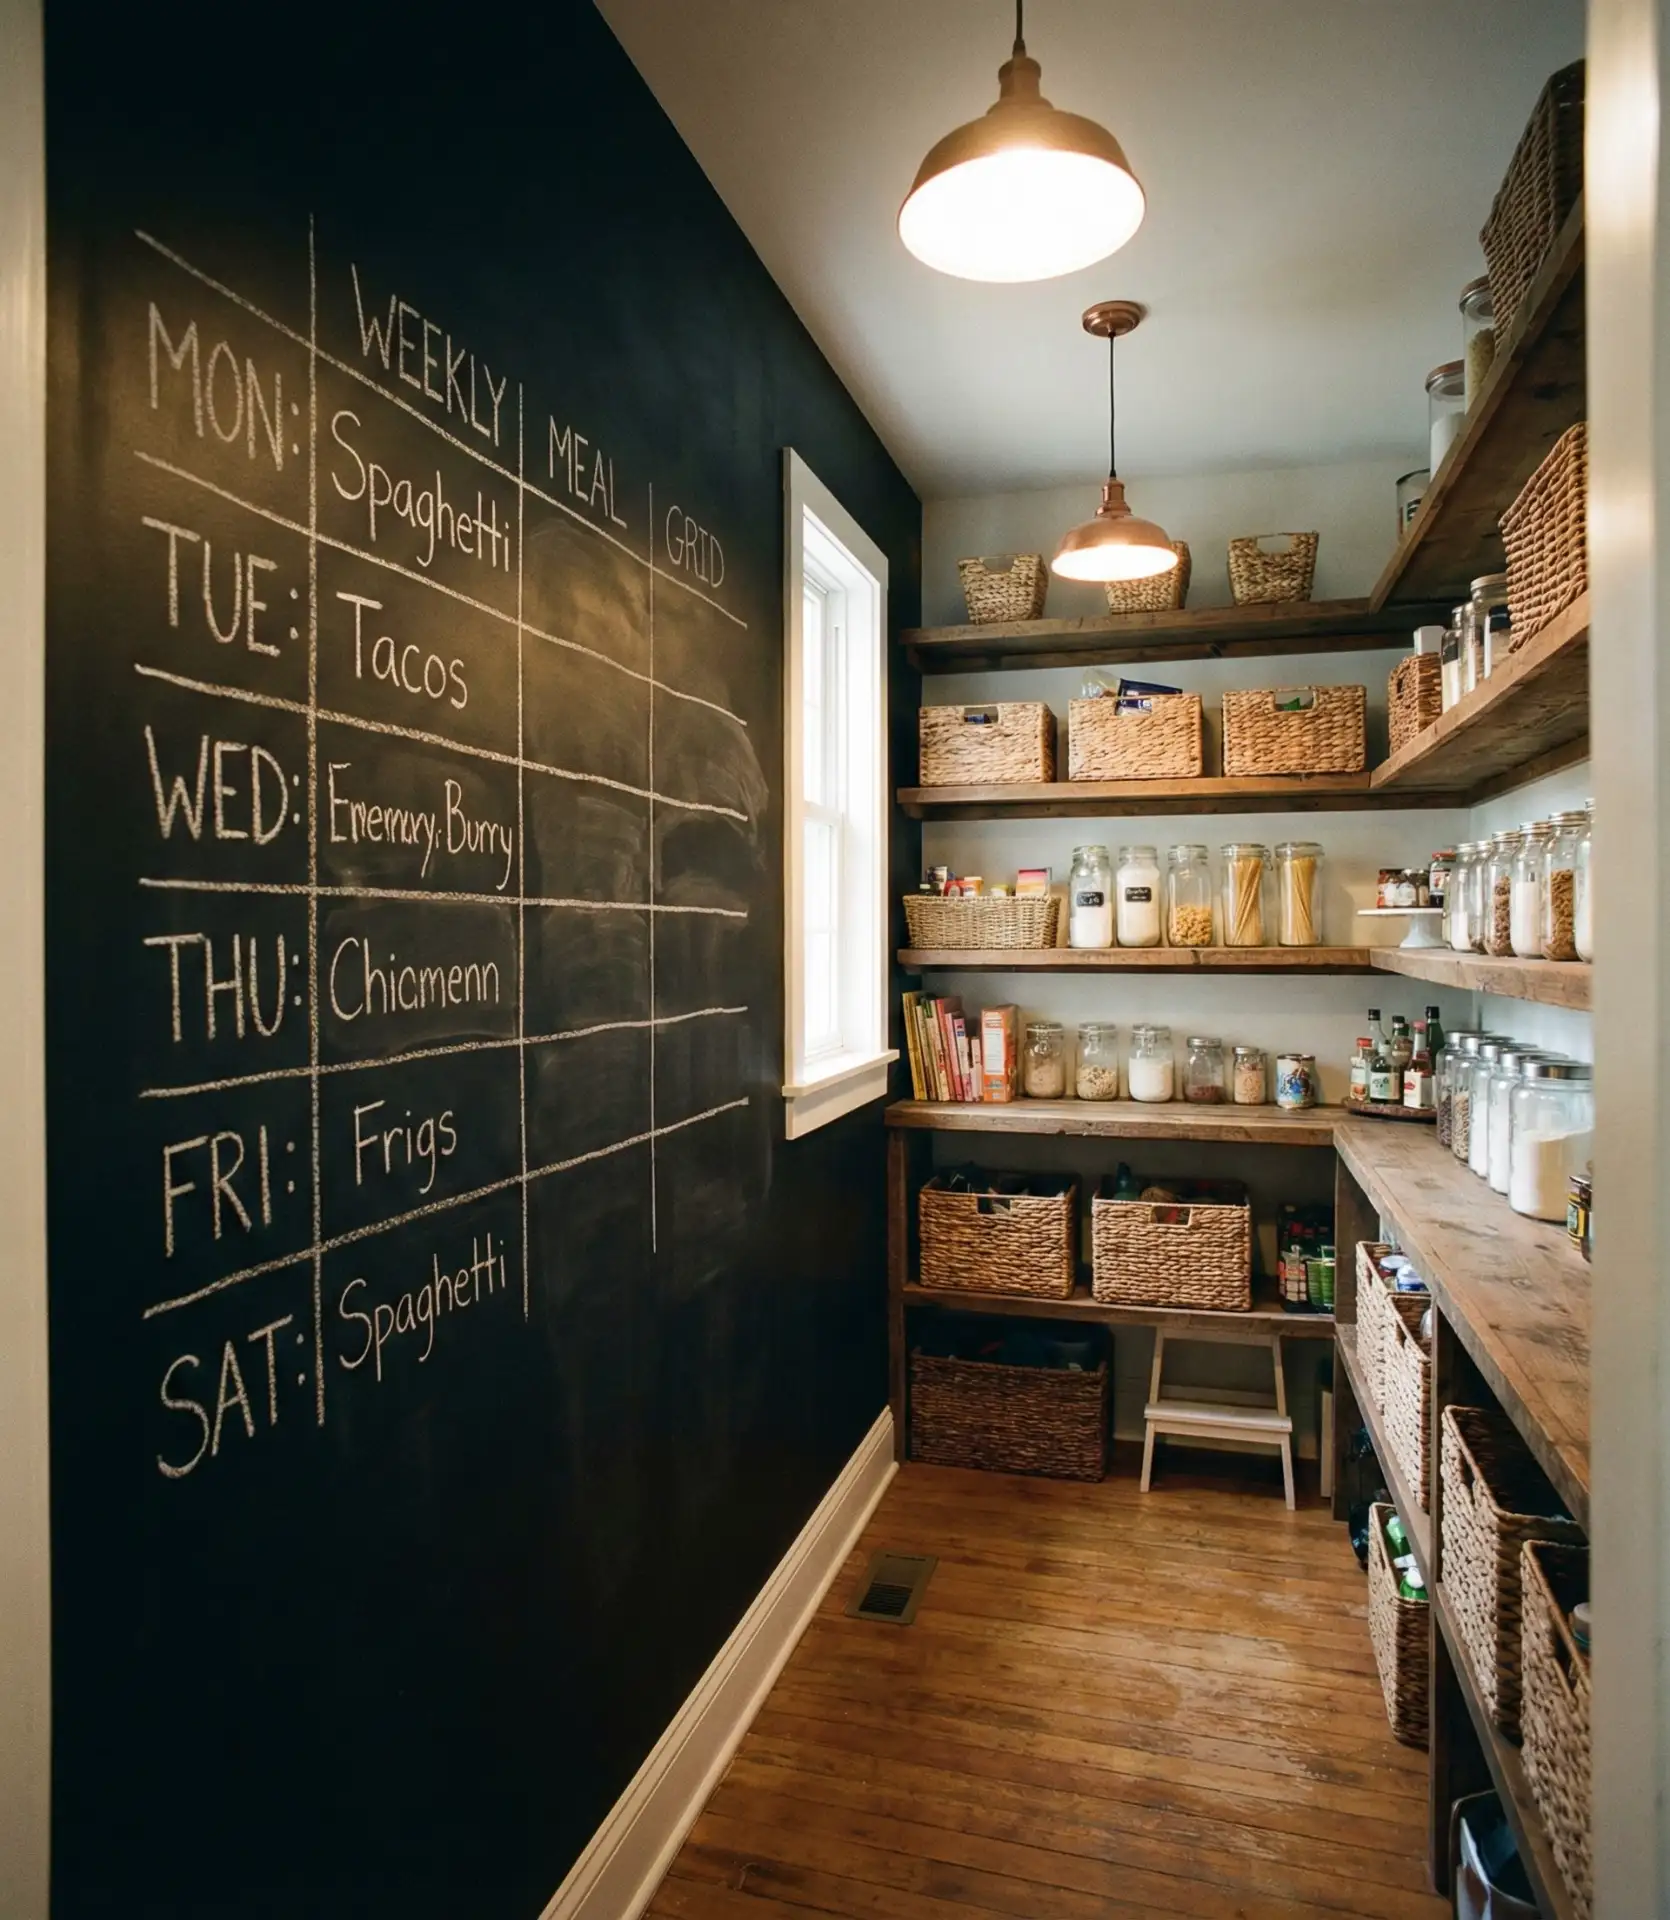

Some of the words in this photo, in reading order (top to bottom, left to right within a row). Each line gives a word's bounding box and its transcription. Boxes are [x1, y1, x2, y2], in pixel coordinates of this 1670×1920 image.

[149, 301, 299, 472] MON:
[351, 263, 507, 447] WEEKLY
[549, 415, 627, 529] MEAL
[667, 504, 724, 588] GRID
[331, 410, 510, 573] Spaghetti
[142, 515, 299, 657] TUE:
[336, 591, 468, 710] Tacos
[144, 724, 301, 846] WED:
[143, 932, 302, 1043] THU:
[163, 1124, 295, 1258] FRI:
[354, 1099, 458, 1194] Frigs
[338, 1232, 506, 1383] Spaghetti
[157, 1313, 306, 1478] SAT:
